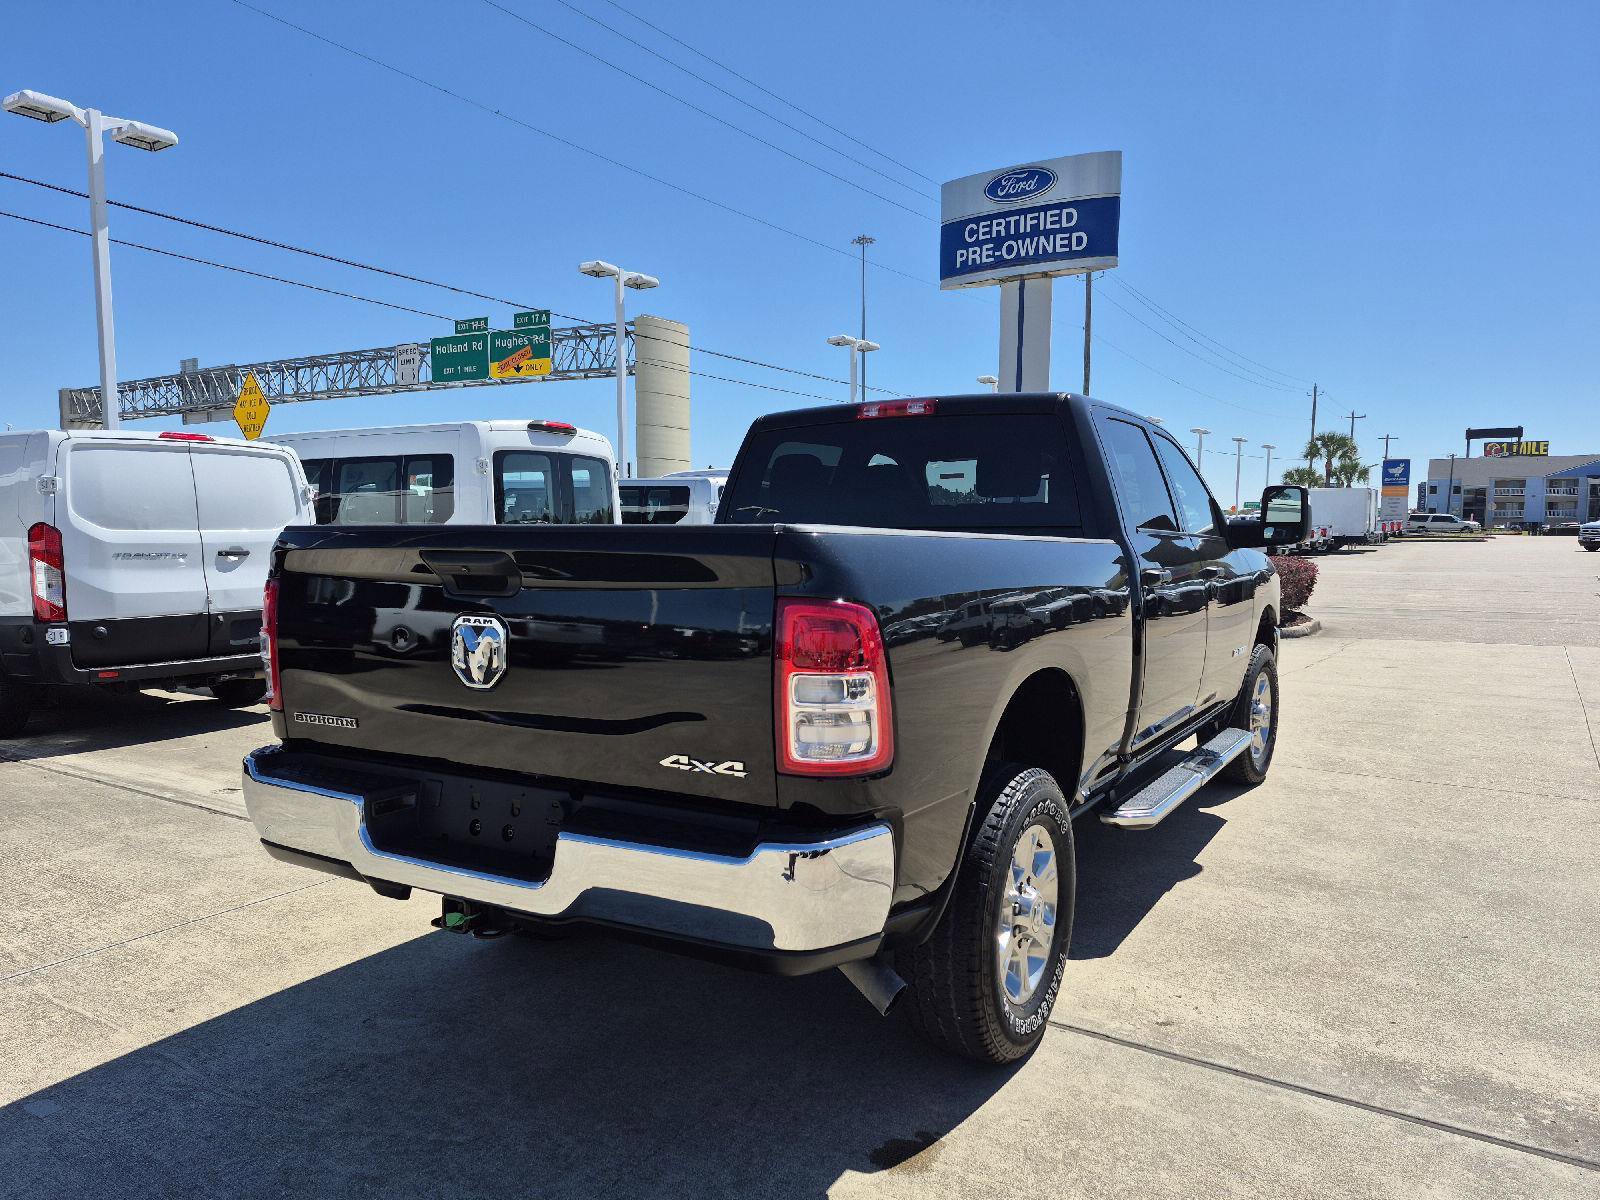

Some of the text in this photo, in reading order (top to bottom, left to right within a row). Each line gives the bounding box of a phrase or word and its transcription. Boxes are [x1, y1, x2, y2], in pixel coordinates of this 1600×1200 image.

[997, 171, 1039, 196] Ford
[964, 207, 1078, 243] CERTIFIED
[956, 231, 1088, 268] PRE-OWNED
[516, 313, 547, 324] EXIT 17 A
[435, 340, 483, 354] Holland Rd
[495, 333, 545, 350] Hughes Rd
[443, 365, 477, 375] EXIT 1 MILE
[525, 362, 544, 371] ONLY
[462, 617, 493, 625] RAM
[294, 712, 359, 728] BIGHORN
[659, 754, 750, 778] 4x4
